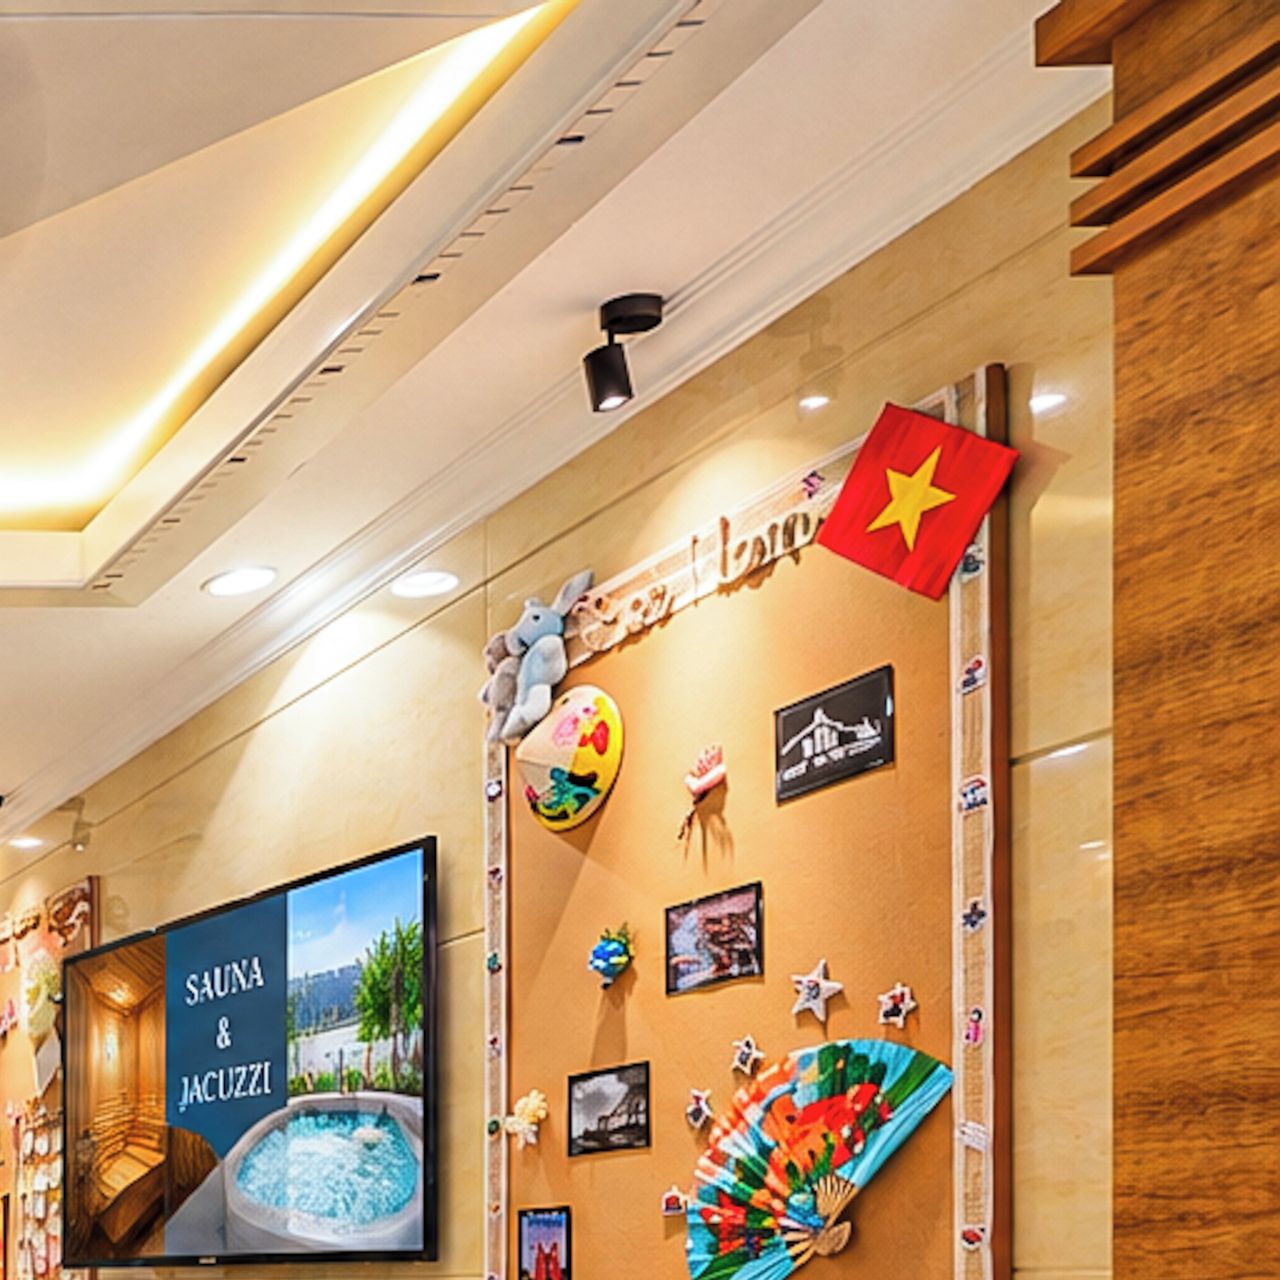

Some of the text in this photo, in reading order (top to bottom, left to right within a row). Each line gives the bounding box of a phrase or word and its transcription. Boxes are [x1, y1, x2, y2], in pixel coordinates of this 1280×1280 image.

[185, 956, 265, 1006] SAUNA
[216, 1016, 232, 1049] &
[178, 1061, 272, 1113] JACUZZI
